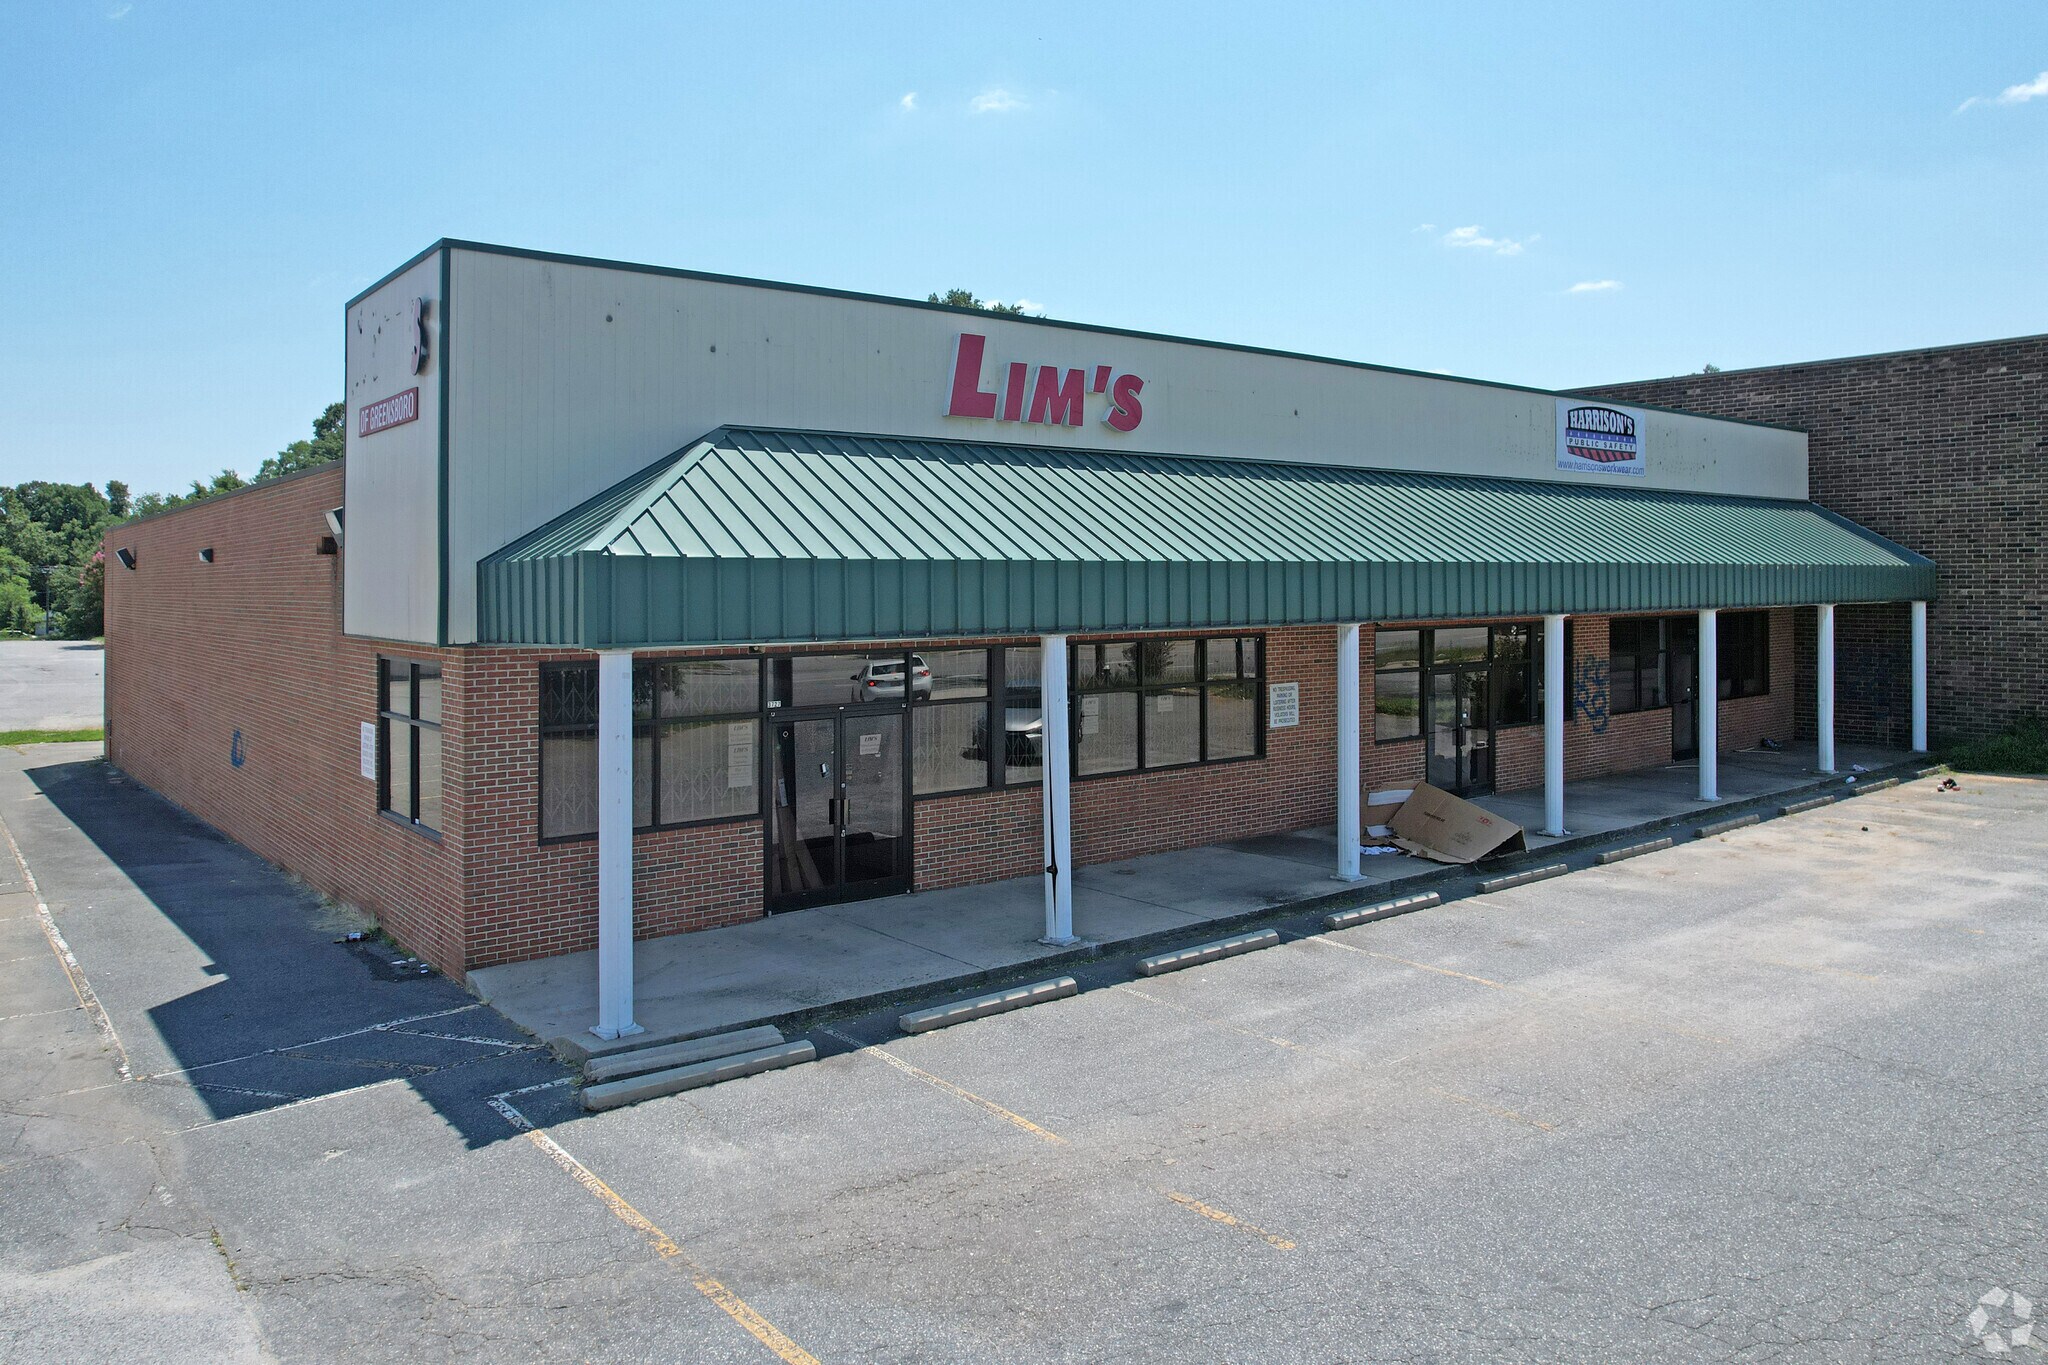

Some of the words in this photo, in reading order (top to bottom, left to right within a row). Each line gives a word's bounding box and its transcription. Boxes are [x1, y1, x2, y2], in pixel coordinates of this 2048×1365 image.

[944, 333, 1144, 432] LIM'S
[361, 409, 369, 433] OF
[370, 392, 414, 430] GREENSBORO
[1569, 409, 1634, 435] HARRISON'S
[1568, 438, 1599, 448] PUBLIC
[1603, 441, 1634, 451] SAFETY
